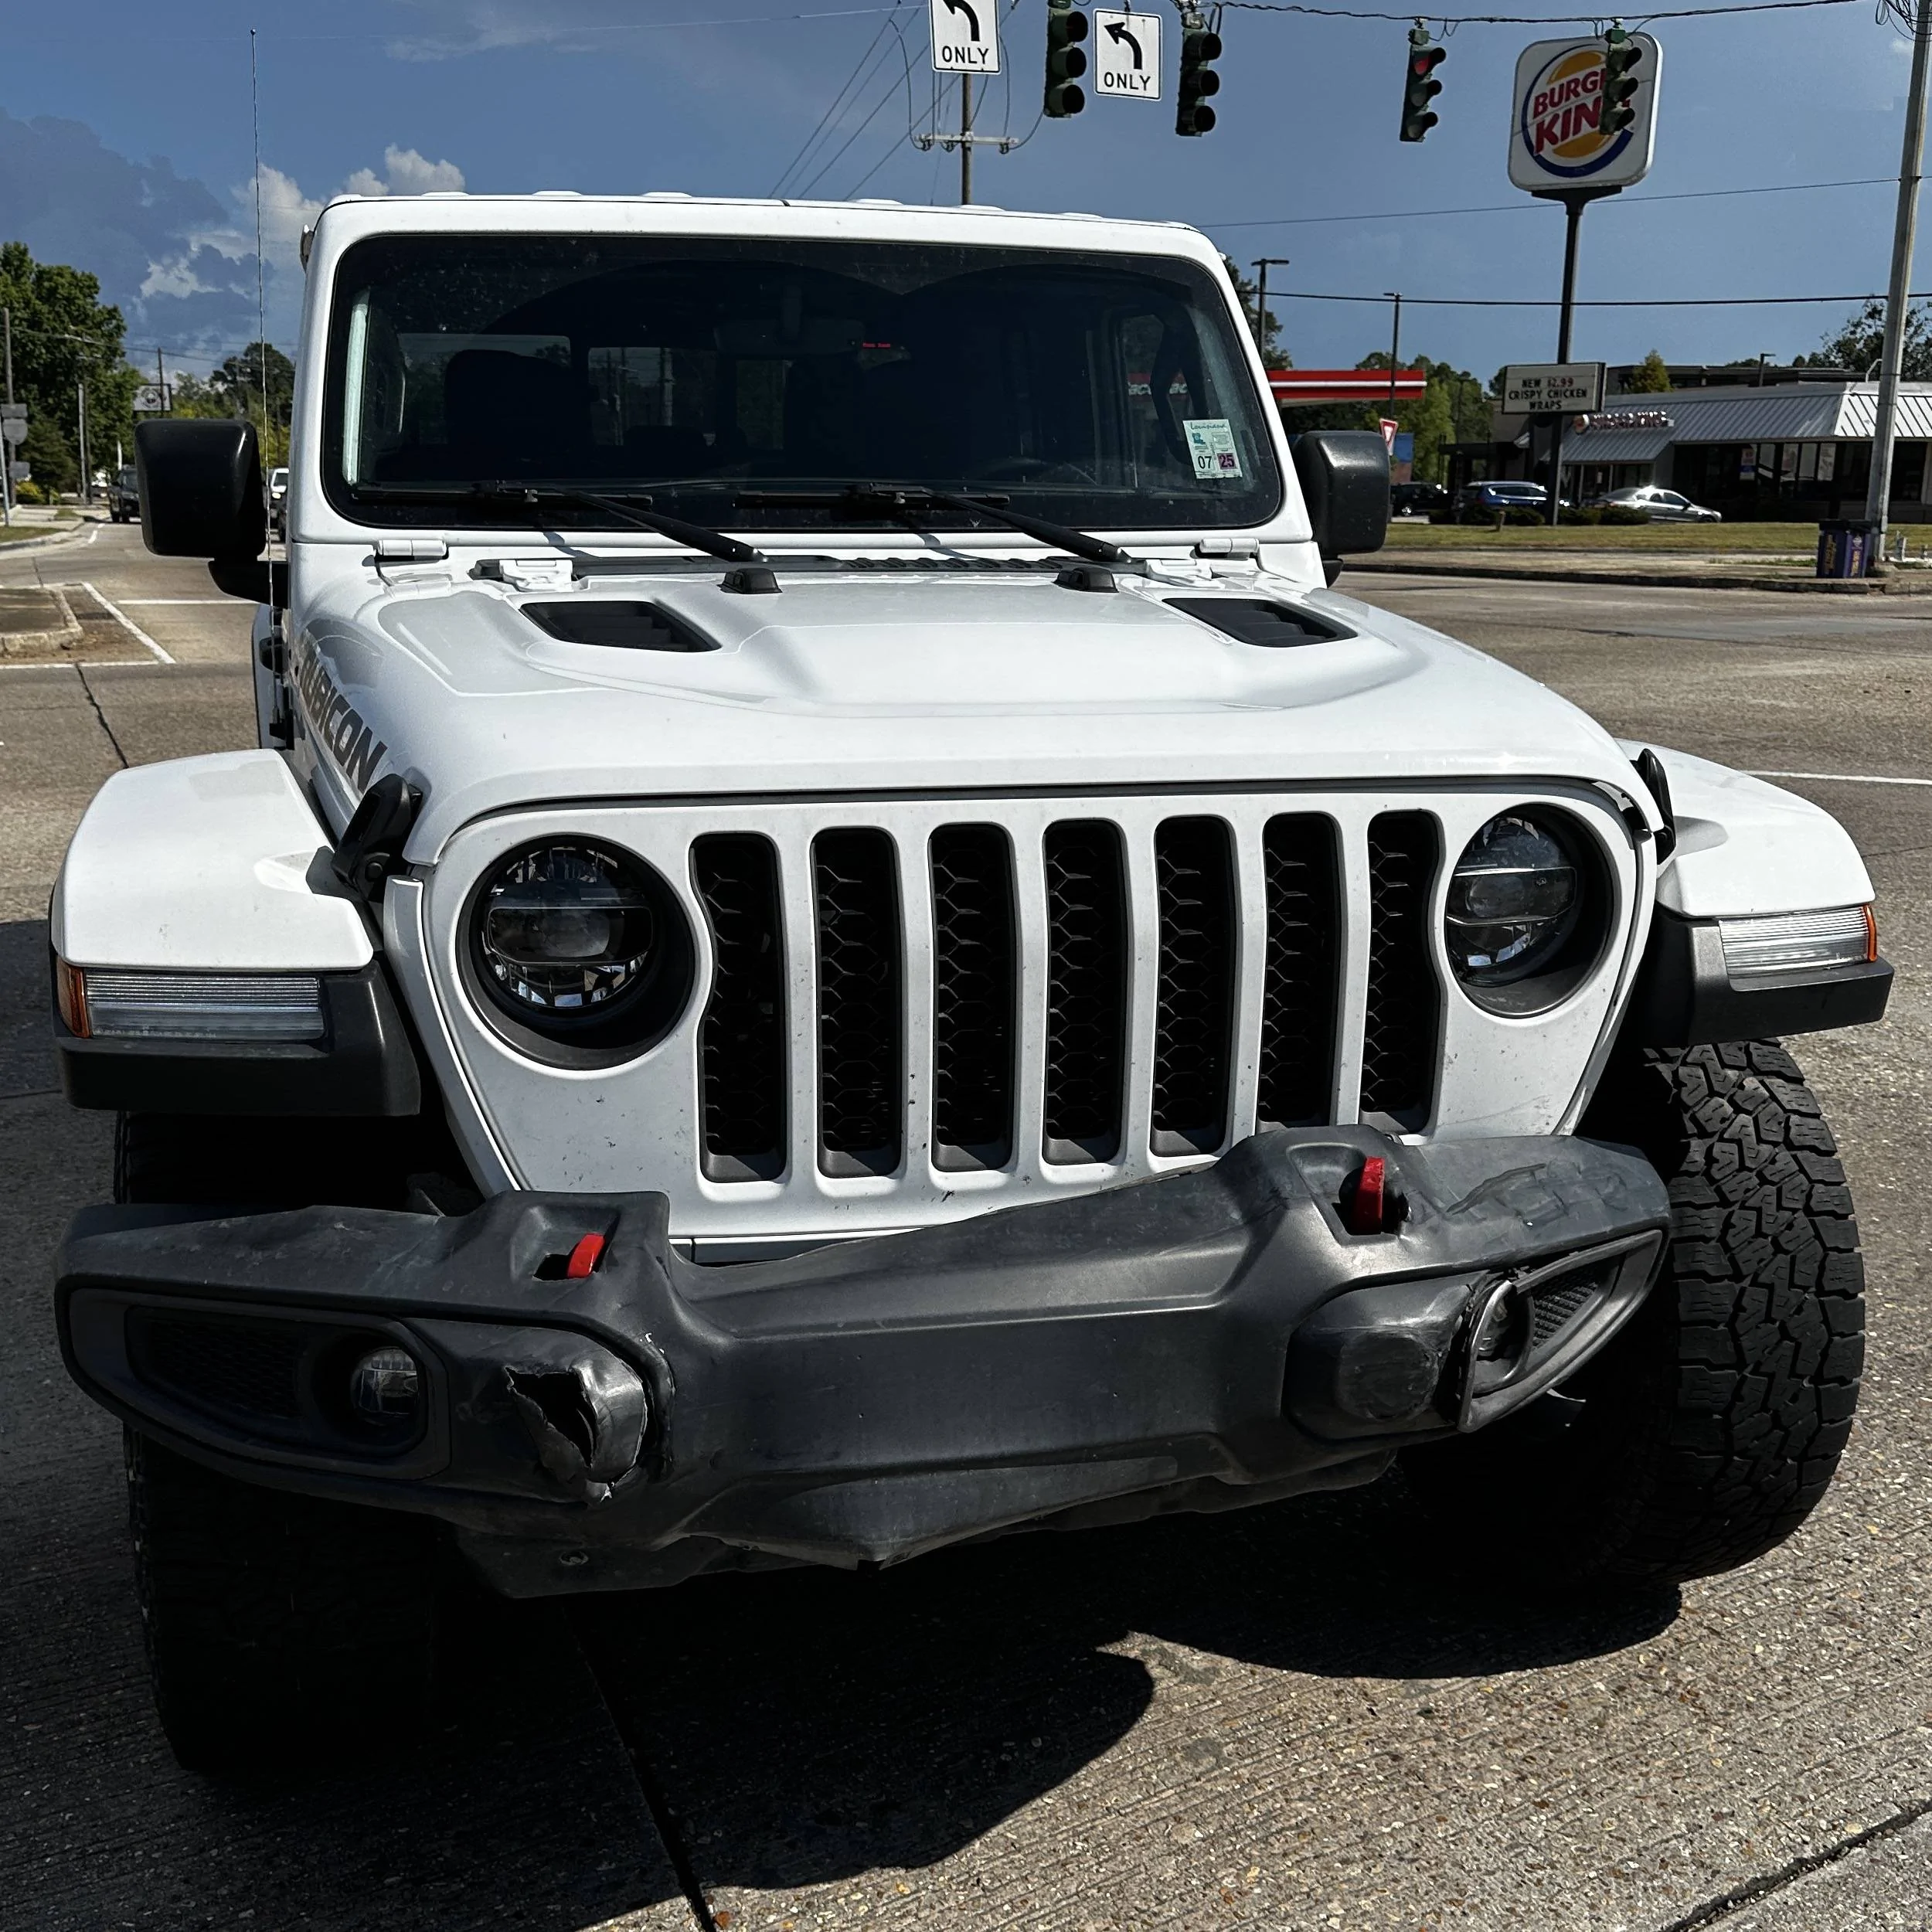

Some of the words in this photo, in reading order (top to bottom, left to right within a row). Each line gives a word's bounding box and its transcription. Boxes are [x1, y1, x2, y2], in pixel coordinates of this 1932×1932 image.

[942, 46, 990, 65] ONLY
[1104, 72, 1151, 91] ONLY
[1532, 68, 1607, 120] BURG
[1533, 95, 1630, 154] KIN
[1521, 378, 1542, 388] NEW
[1509, 389, 1543, 400] CRISPY
[1547, 388, 1587, 399] CHICKEN
[1529, 400, 1562, 410] WRAPS
[1197, 455, 1212, 469] 07
[1219, 454, 1235, 468] 25
